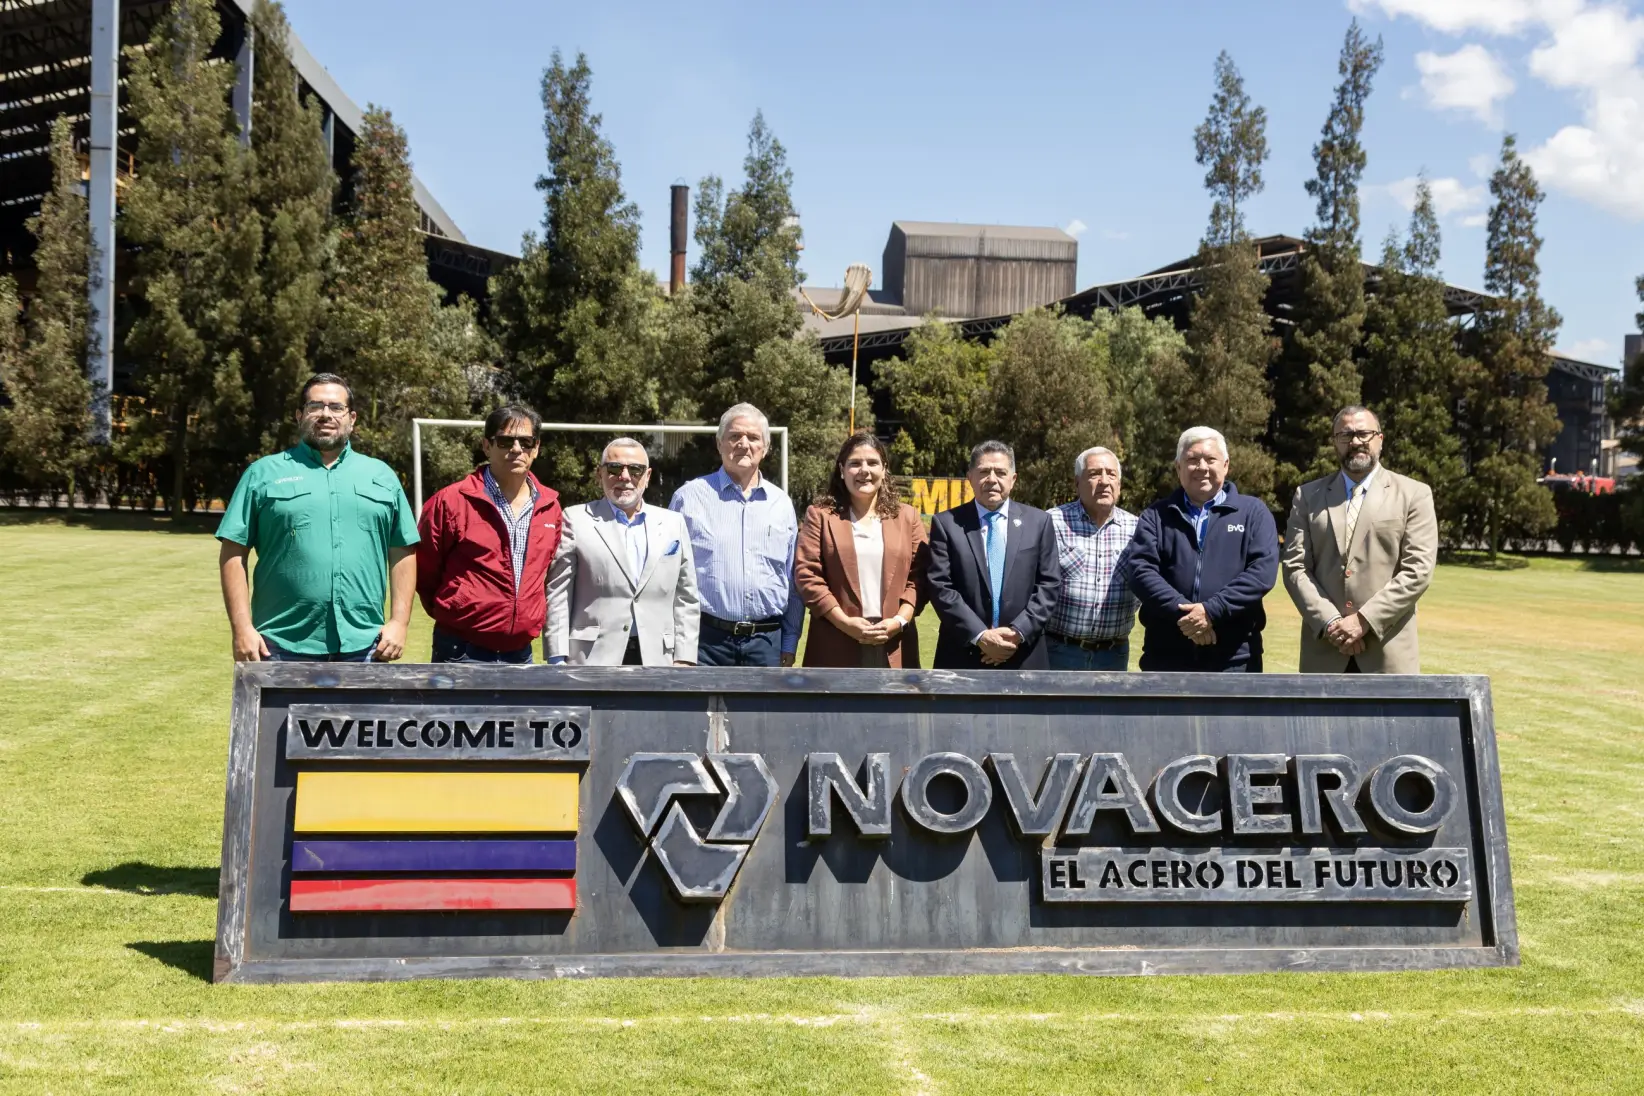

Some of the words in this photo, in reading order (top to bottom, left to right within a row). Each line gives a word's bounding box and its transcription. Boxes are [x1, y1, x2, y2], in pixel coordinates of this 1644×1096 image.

[298, 720, 515, 748] WELCOME
[529, 721, 582, 748] TO
[808, 751, 1458, 837] NOVACERO
[1050, 860, 1086, 889] EL
[1099, 860, 1225, 889] ACERO
[1236, 860, 1302, 889] DEL
[1314, 860, 1459, 889] FUTURO
